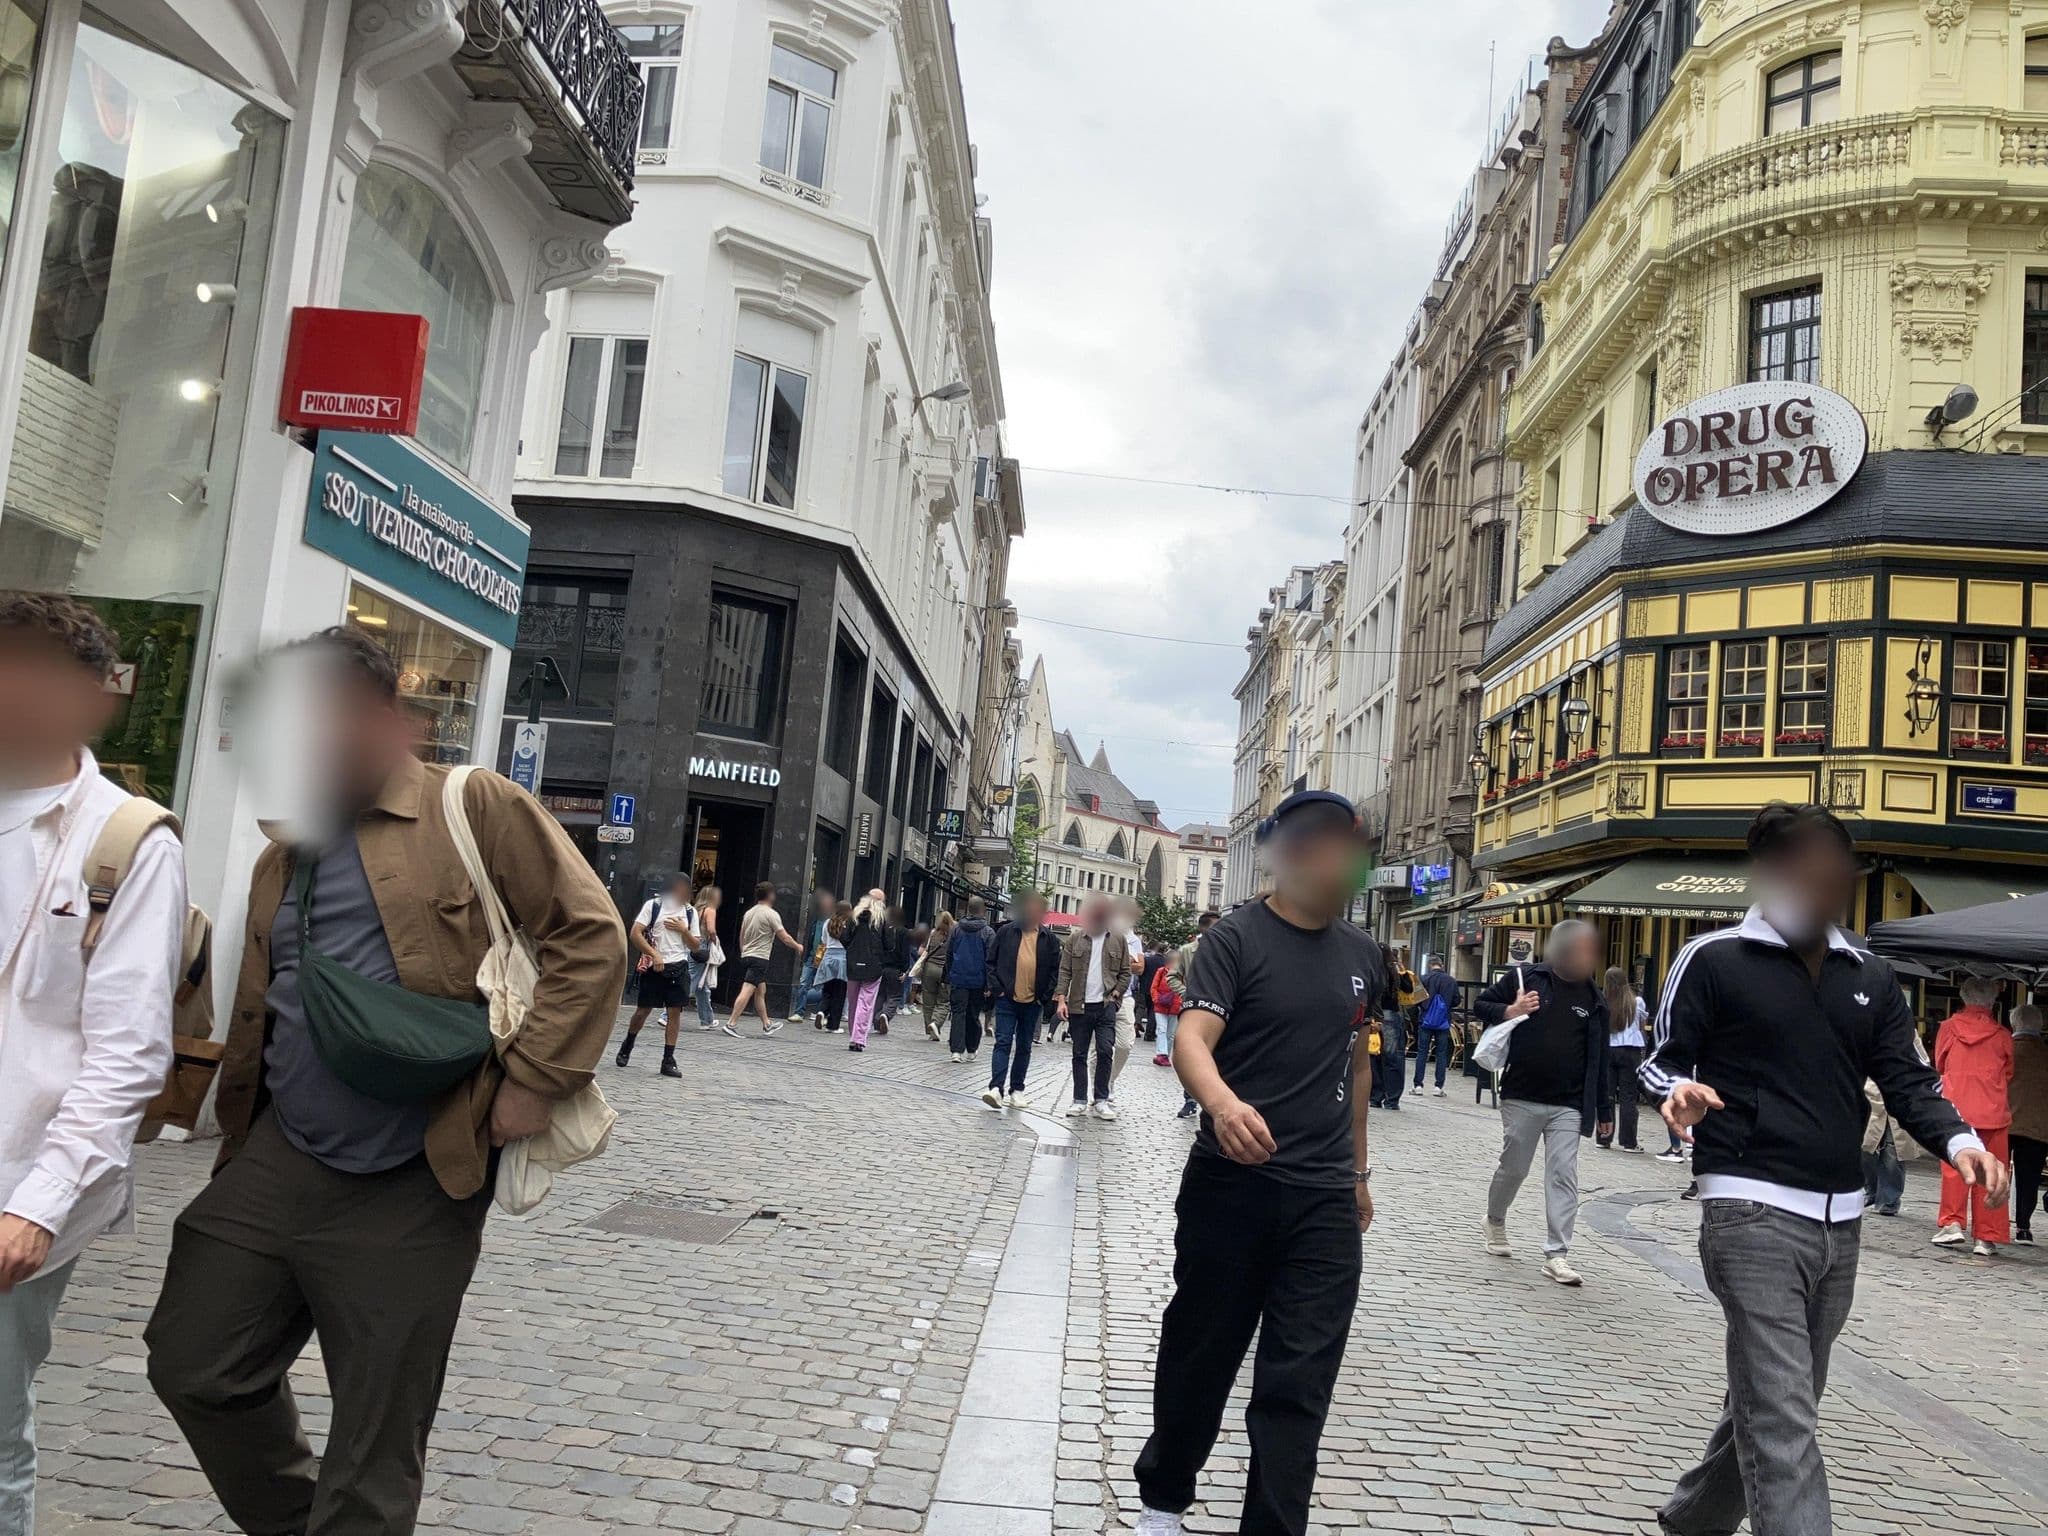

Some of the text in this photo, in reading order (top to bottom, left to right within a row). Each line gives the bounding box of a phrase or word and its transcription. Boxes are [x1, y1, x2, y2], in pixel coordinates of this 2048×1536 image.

[304, 393, 376, 415] PIKOLINOS
[1662, 396, 1816, 457] DRUG
[1644, 445, 1839, 507] OPERA
[420, 498, 460, 539] maison
[459, 520, 474, 546] de
[430, 536, 521, 615] CHOCOLATS
[688, 756, 782, 788] MANFIELD
[858, 814, 871, 856] MANFIELD
[1655, 882, 1747, 894] OPERA
[1577, 905, 1594, 913] PASTA
[1651, 908, 1672, 917] TAVERN
[1672, 909, 1705, 918] RESTAURANT
[1710, 910, 1728, 919] PIZZA
[1733, 911, 1744, 920] PUB
[1198, 1000, 1226, 1016] PARIS
